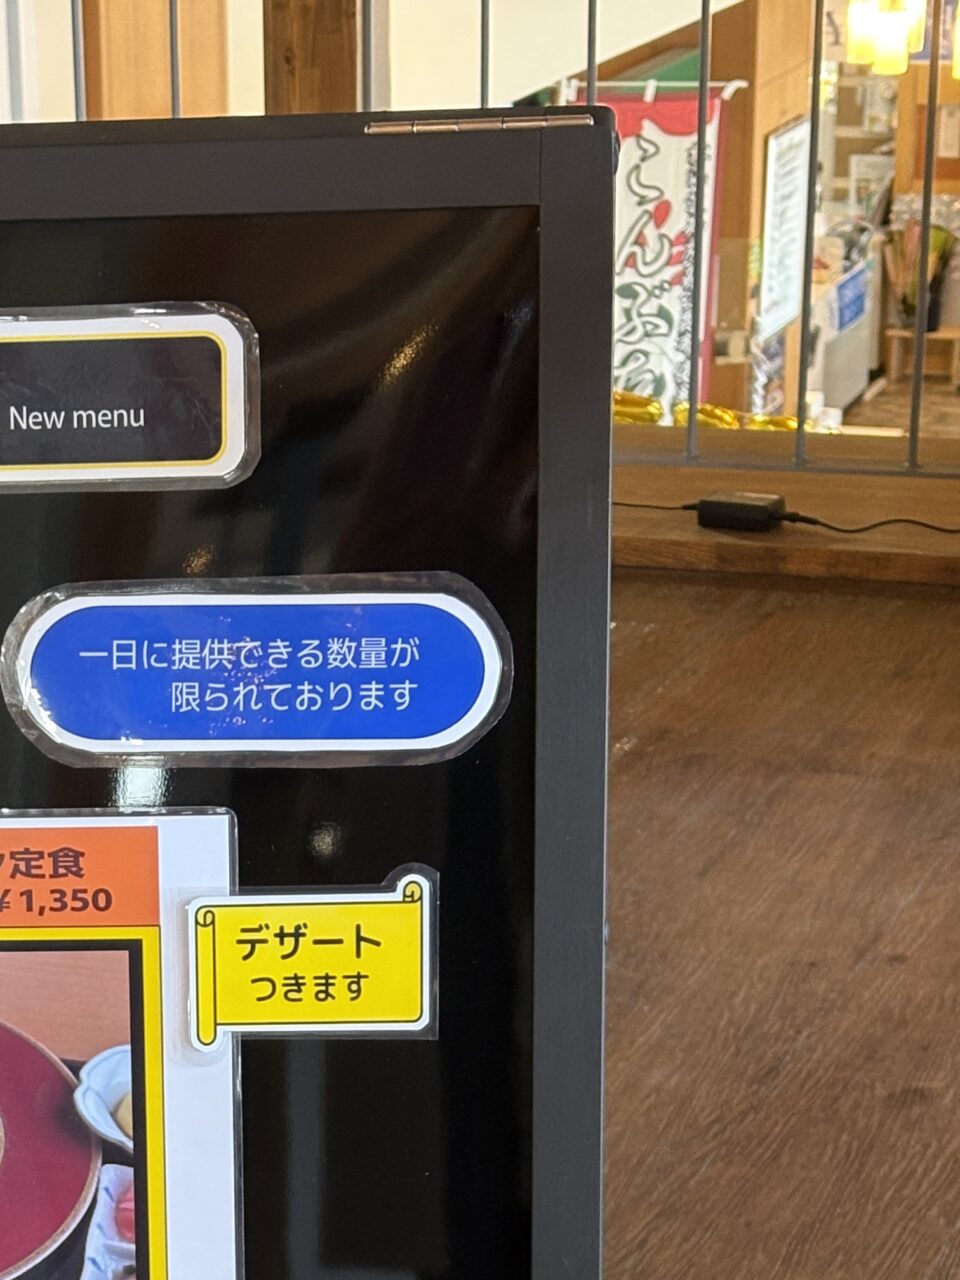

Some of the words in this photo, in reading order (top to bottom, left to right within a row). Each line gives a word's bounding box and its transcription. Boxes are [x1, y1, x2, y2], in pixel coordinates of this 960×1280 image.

[9, 405, 66, 431] New
[72, 408, 145, 430] menu
[79, 636, 420, 671] 一日に提供できる数量が
[171, 679, 418, 713] 限られております
[235, 921, 382, 962] デザート
[250, 970, 370, 1003] つきます
